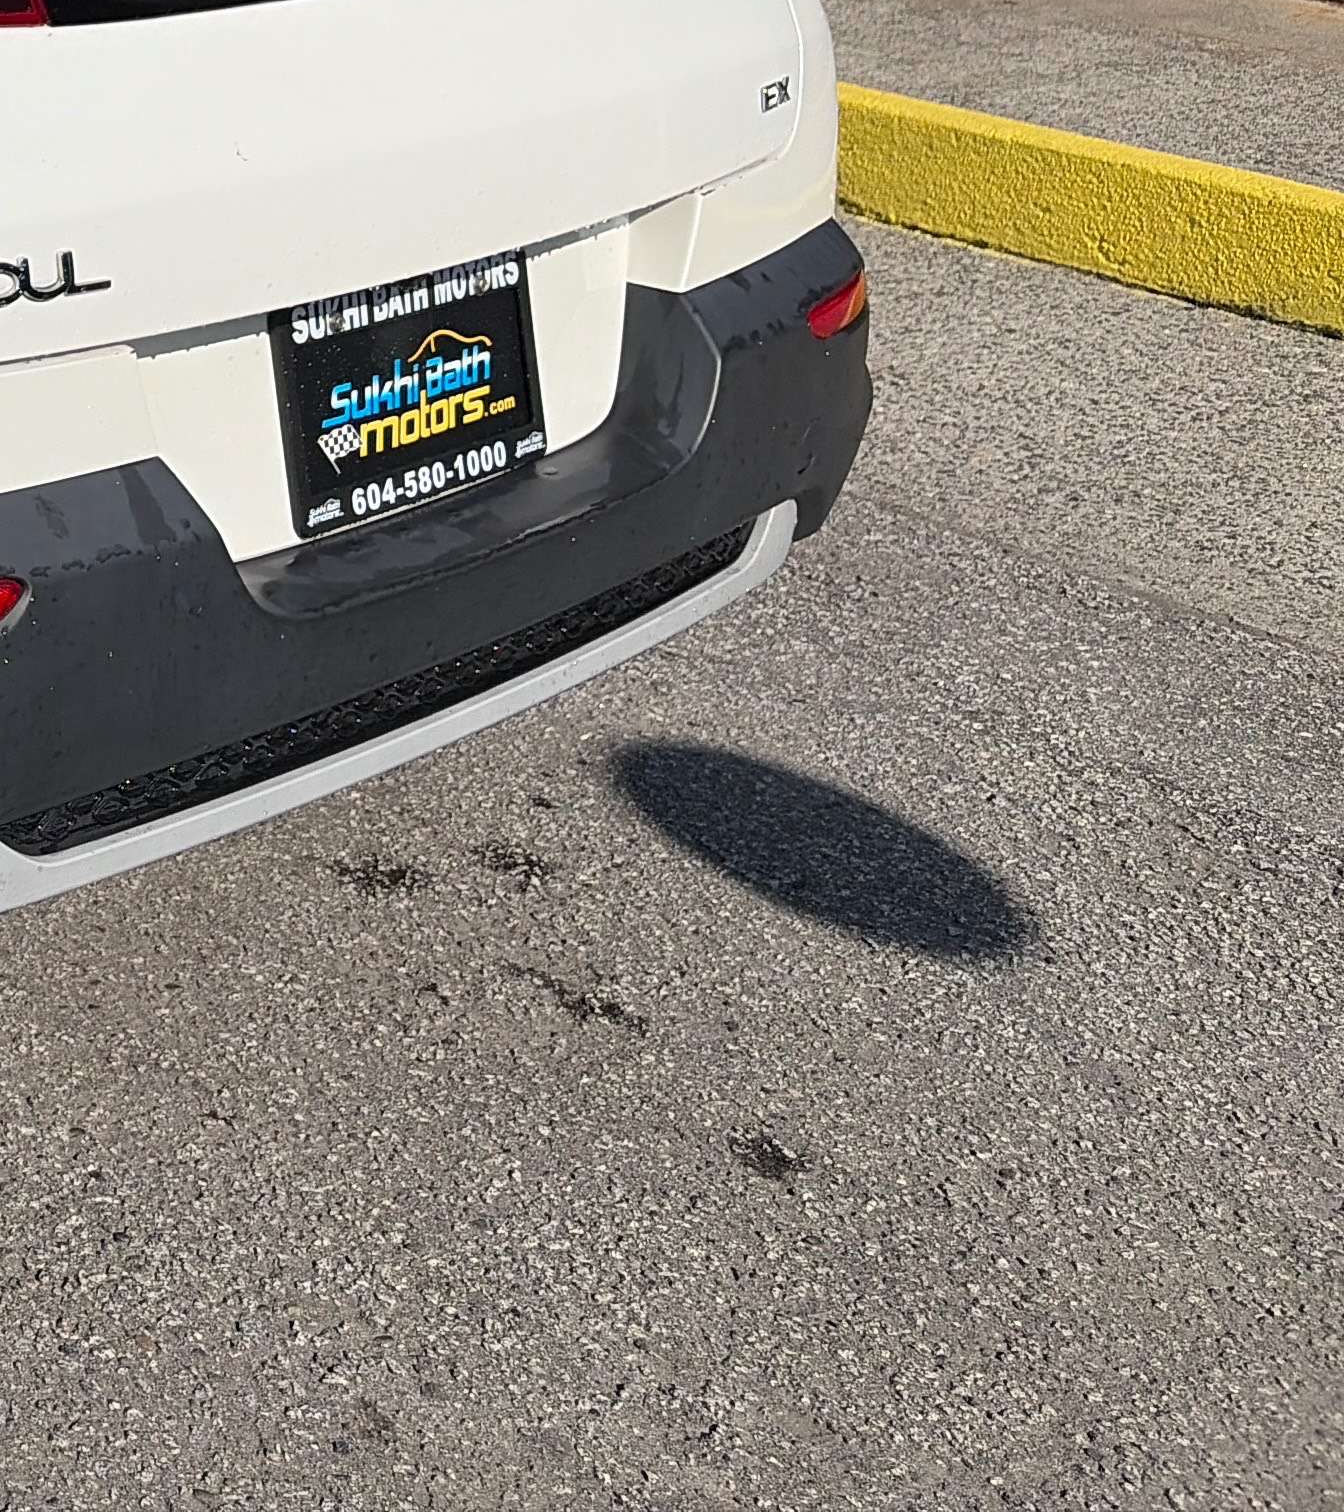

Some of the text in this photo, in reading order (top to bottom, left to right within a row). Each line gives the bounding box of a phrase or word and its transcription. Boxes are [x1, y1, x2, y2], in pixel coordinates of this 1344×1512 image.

[760, 75, 791, 113] EX
[321, 345, 491, 428] Sukhi Bath
[351, 440, 507, 516] 604-580-1000
